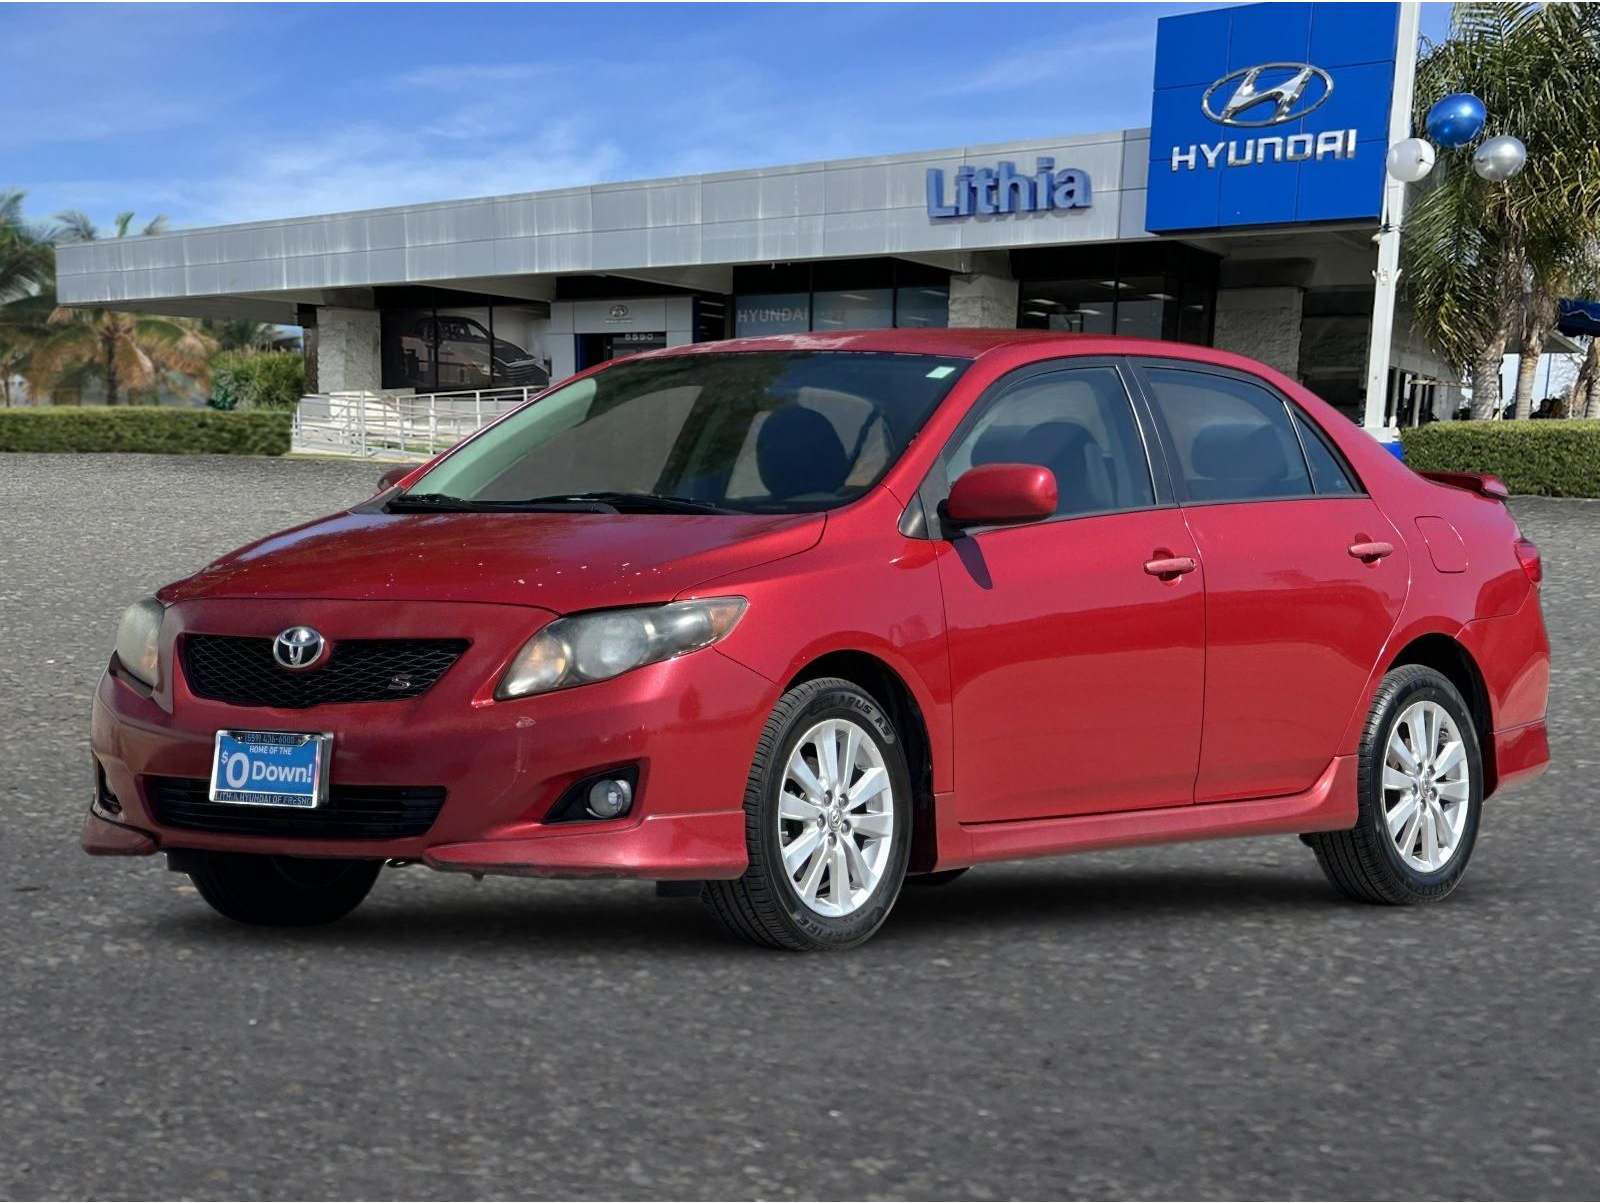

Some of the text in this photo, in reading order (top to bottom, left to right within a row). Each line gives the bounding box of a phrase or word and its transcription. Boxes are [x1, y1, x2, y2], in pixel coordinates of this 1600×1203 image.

[1171, 128, 1357, 172] HYUNDAI
[926, 157, 1092, 219] Lithia
[737, 307, 809, 323] HYUNDAI
[249, 745, 293, 756] HOME OF THE
[252, 760, 313, 784] Down!
[240, 792, 271, 803] HYUNDAI
[272, 794, 282, 804] OF
